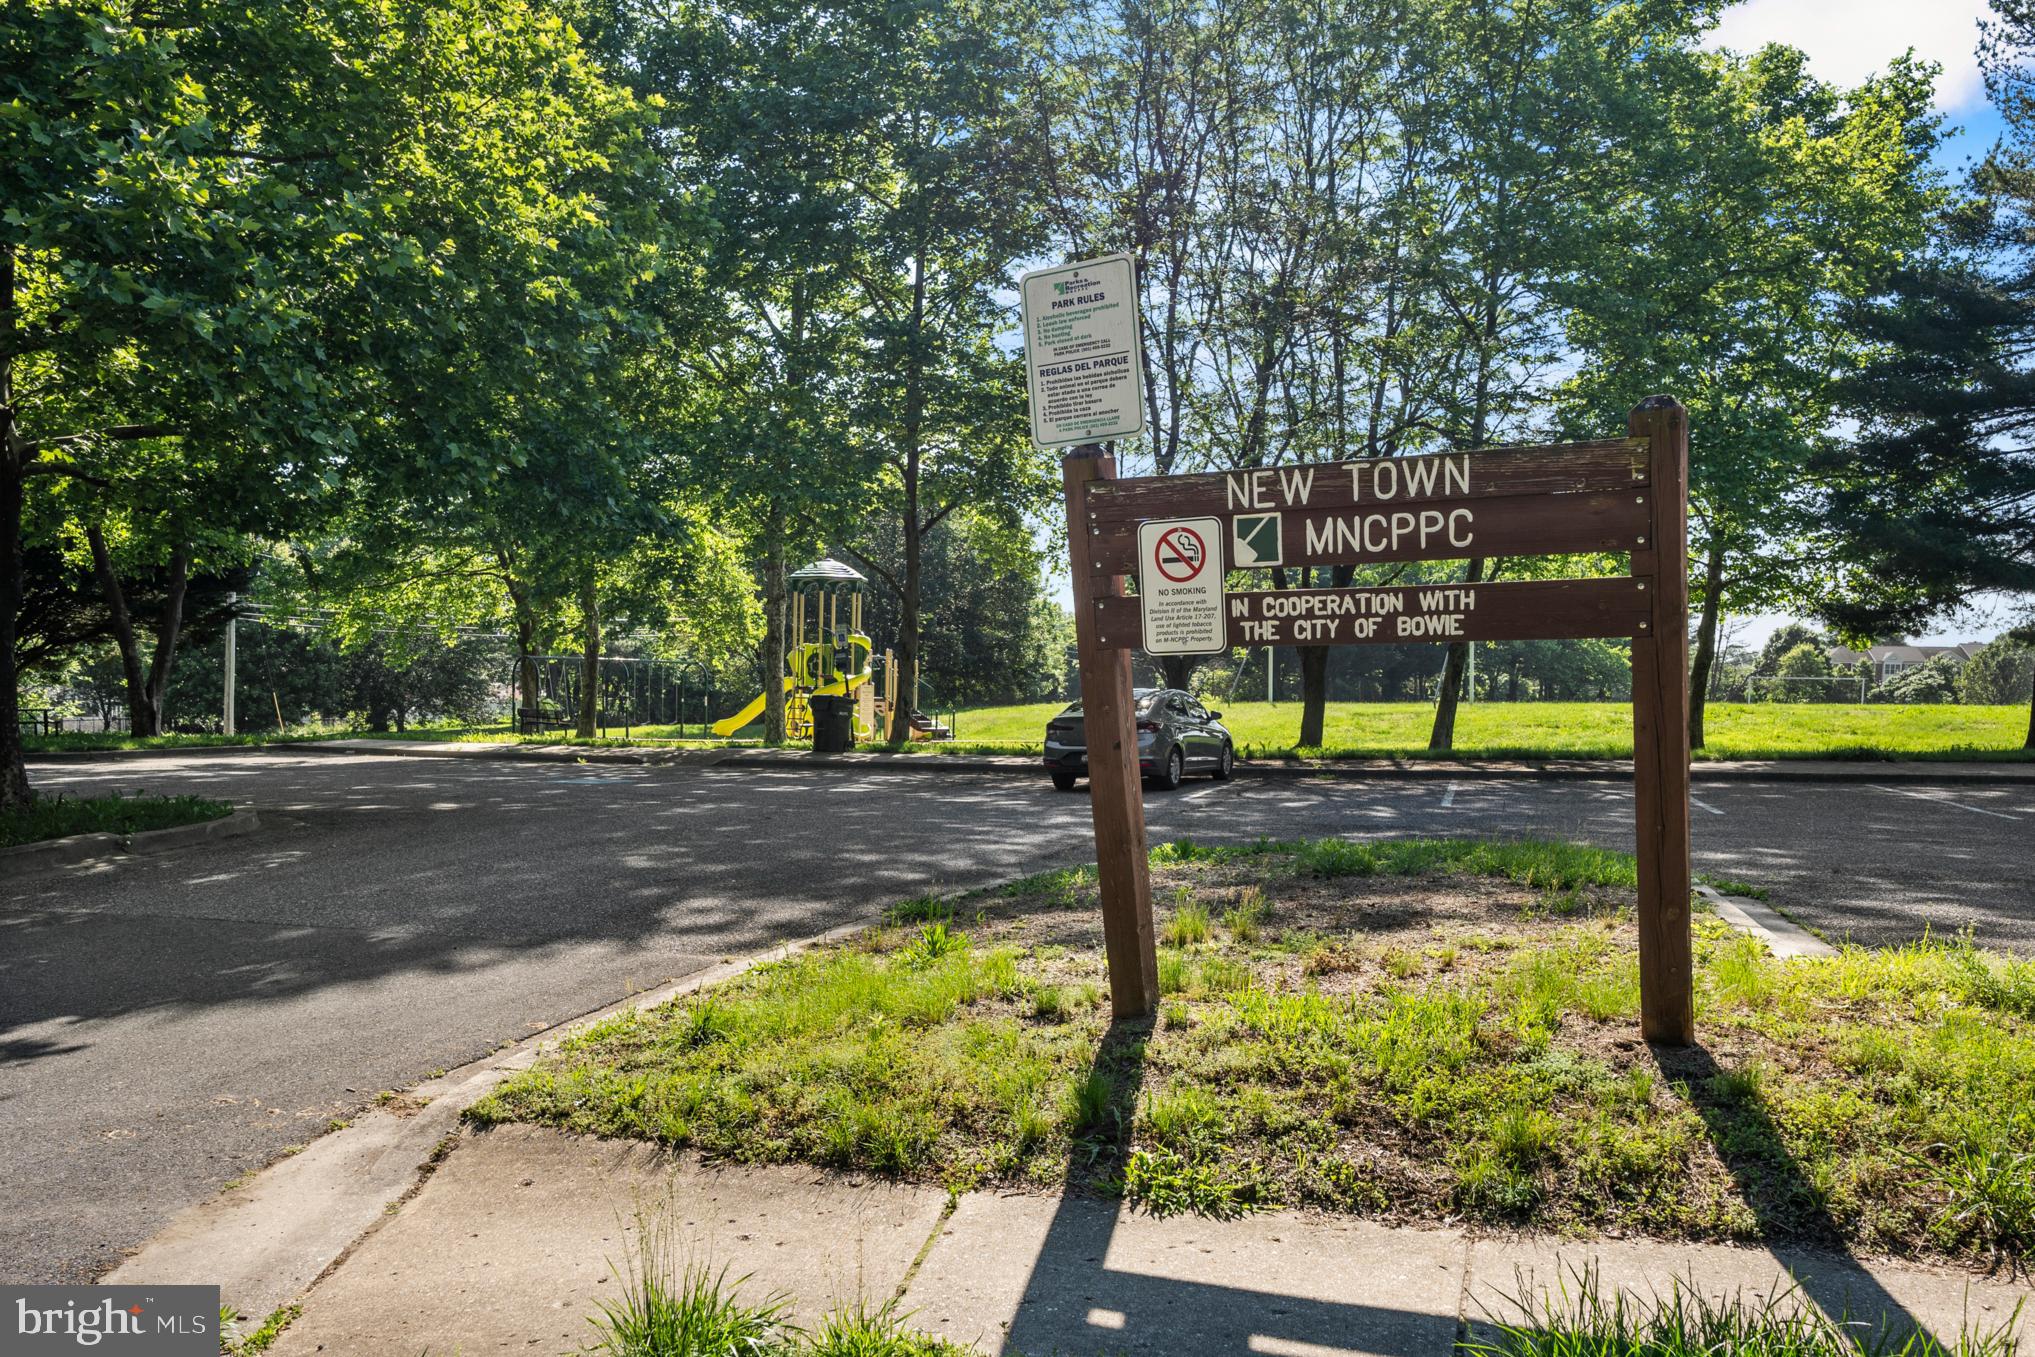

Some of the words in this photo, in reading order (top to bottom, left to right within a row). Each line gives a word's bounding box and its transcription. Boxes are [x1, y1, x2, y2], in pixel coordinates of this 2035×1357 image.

[1065, 281, 1100, 291] Recreation
[1052, 298, 1075, 309] PARK
[1077, 292, 1105, 304] RULES
[1066, 308, 1091, 317] beverages
[1093, 302, 1119, 312] prohibited
[1052, 324, 1072, 332] dumping
[1040, 365, 1072, 377] REGLAS
[1075, 362, 1091, 372] DEL
[1093, 356, 1128, 368] PARQUE
[1046, 377, 1072, 385] Prohibidas
[1227, 468, 1314, 510] NEW
[1342, 454, 1470, 502] TOWN
[1306, 508, 1474, 556] MNCPPC
[1171, 587, 1206, 595] SMOKING
[1232, 597, 1248, 617] IN
[1263, 592, 1403, 617] COOPERATION
[1420, 590, 1474, 612] WITH
[1240, 620, 1280, 641] THE
[1294, 619, 1339, 640] CITY
[1355, 617, 1382, 638] OF
[1397, 615, 1465, 636] BOWIE
